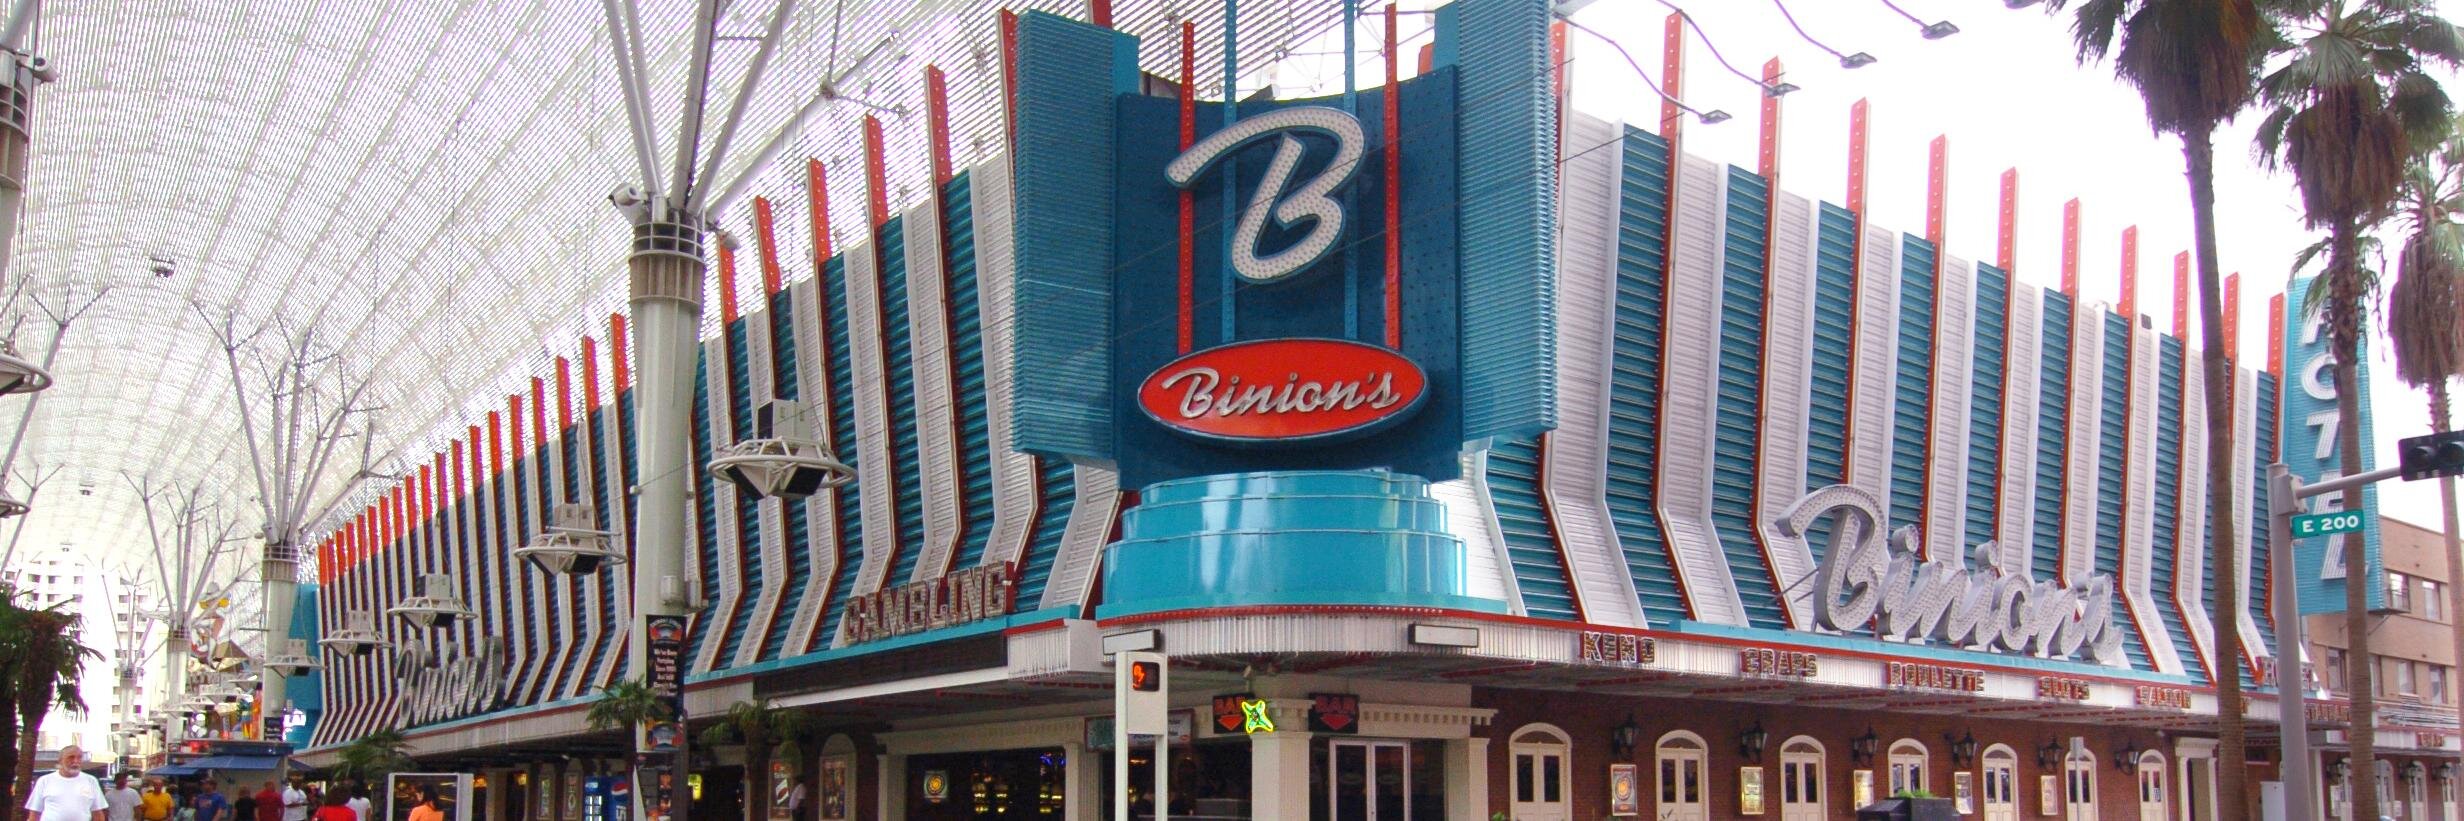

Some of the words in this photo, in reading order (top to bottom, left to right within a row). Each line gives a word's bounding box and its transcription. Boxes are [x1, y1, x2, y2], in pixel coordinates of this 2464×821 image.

[1165, 107, 1364, 282] B
[1161, 367, 1400, 419] Binion's
[2302, 520, 2314, 532] E
[2321, 515, 2359, 531] 200
[1775, 484, 2125, 665] Binion's
[844, 560, 1010, 646] GAMBLING
[1583, 631, 1655, 663] KENO
[1743, 648, 1817, 677] CRAPS
[1889, 661, 1985, 692] ROULETTE
[2038, 676, 2090, 700] SLOTS
